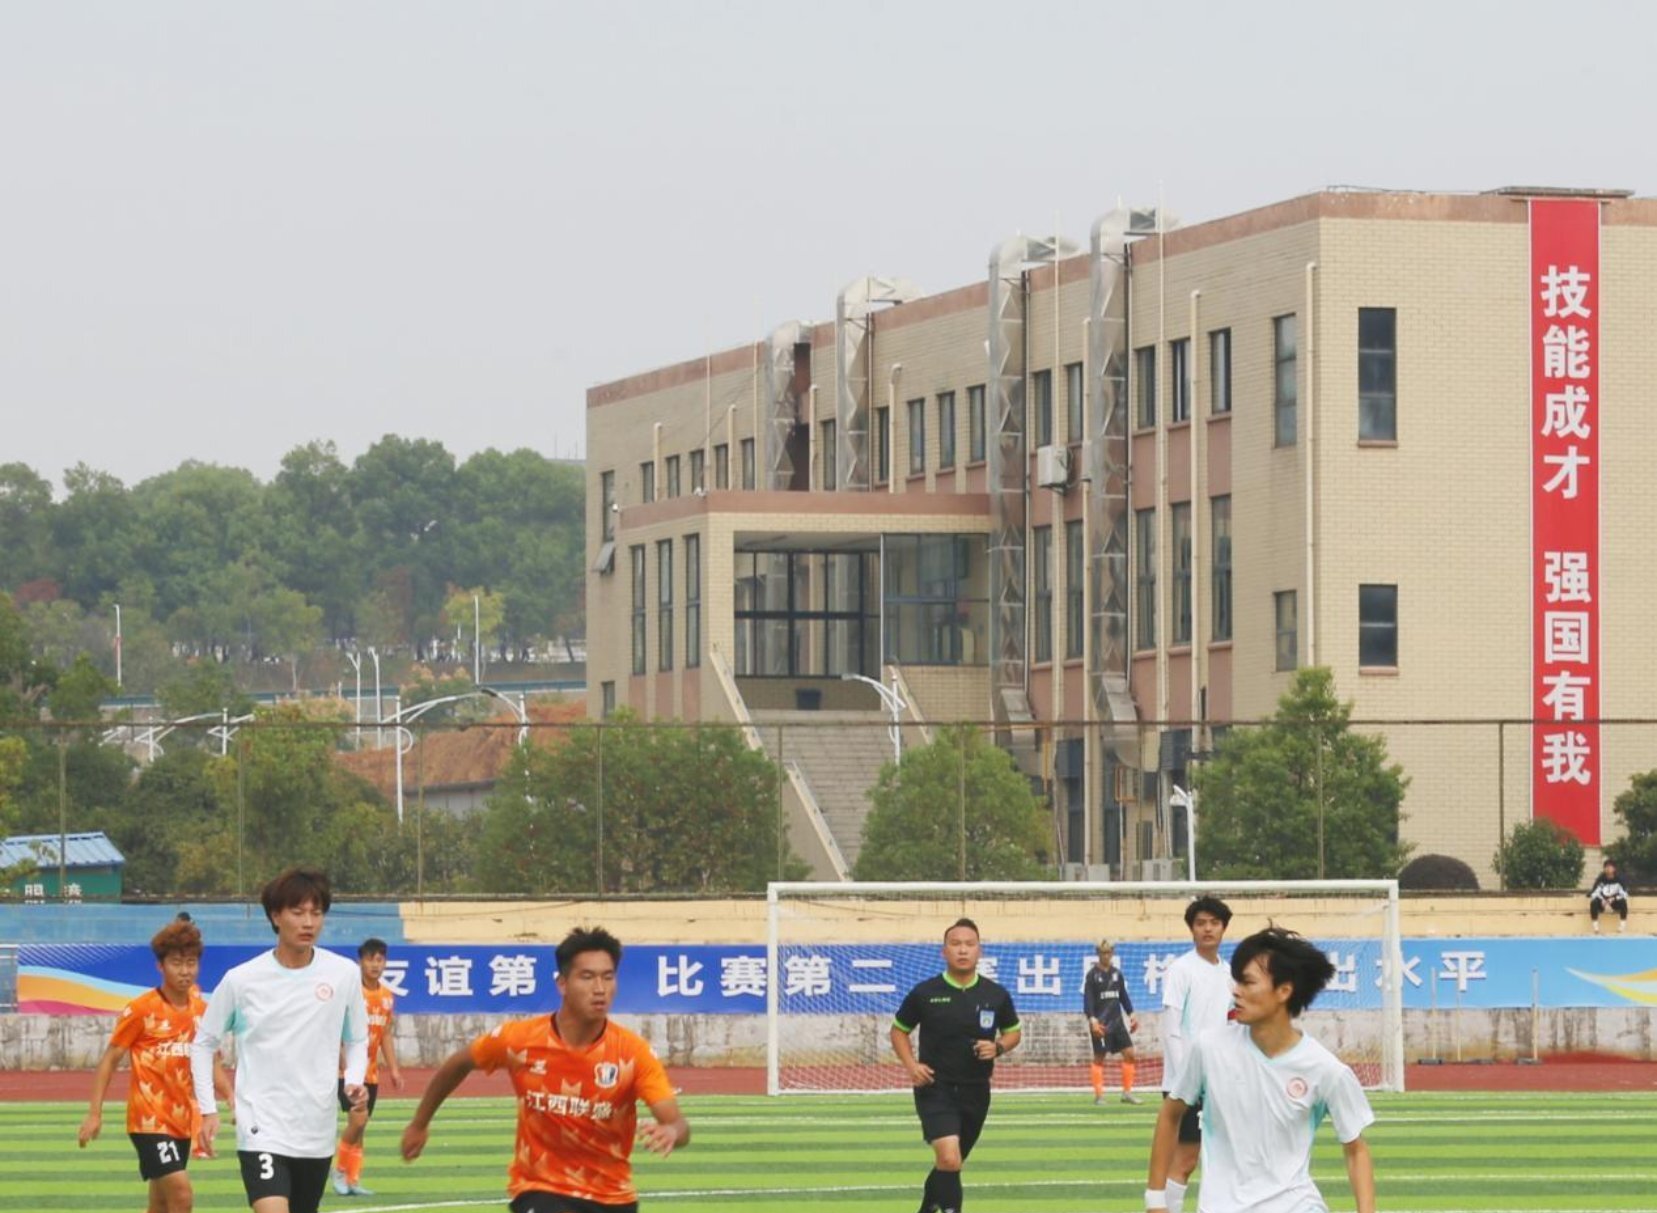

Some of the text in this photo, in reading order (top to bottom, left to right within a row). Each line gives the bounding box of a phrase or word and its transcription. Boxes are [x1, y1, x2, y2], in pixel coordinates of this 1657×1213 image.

[1540, 264, 1592, 786] 技能成才 强国有我
[378, 954, 560, 997] 友谊第
[656, 954, 897, 997] 比赛第二
[157, 1140, 180, 1164] 21
[258, 1152, 275, 1180] 3
